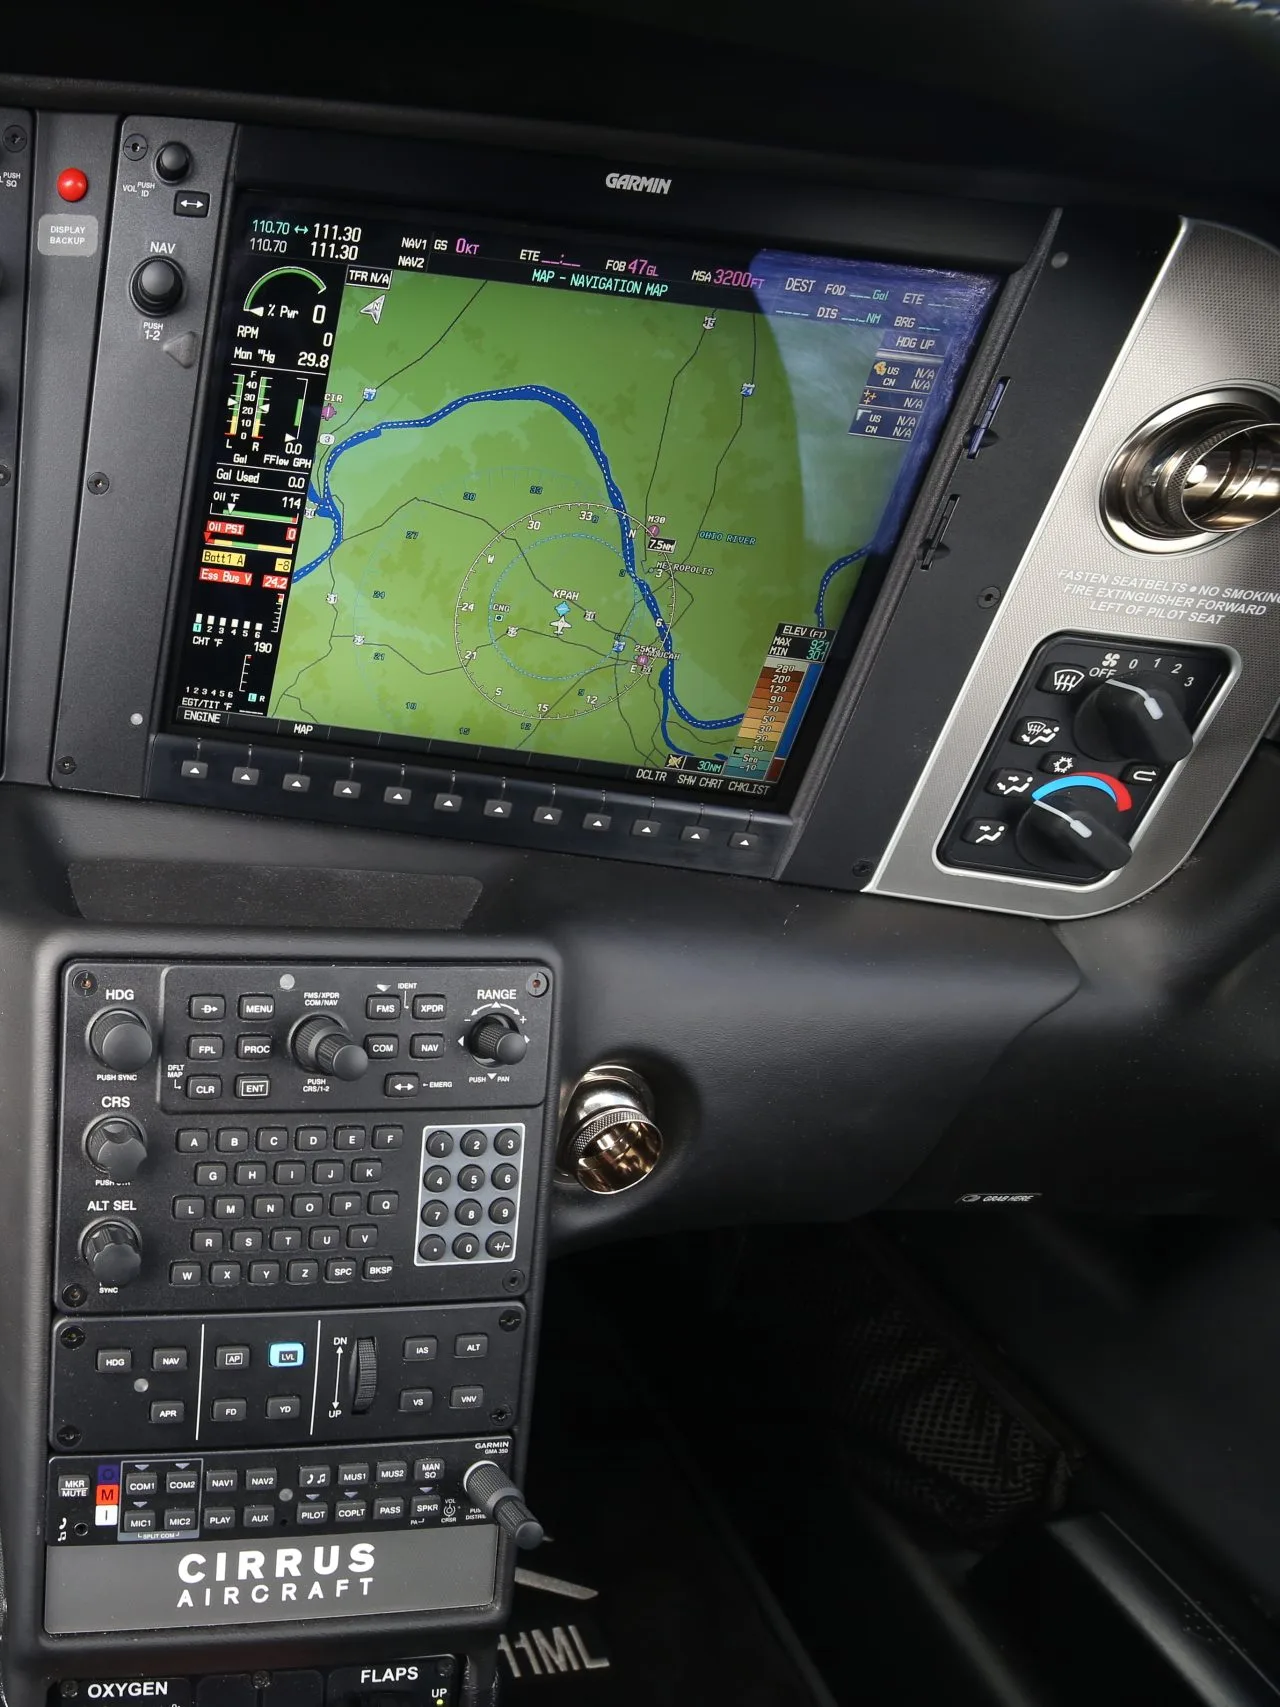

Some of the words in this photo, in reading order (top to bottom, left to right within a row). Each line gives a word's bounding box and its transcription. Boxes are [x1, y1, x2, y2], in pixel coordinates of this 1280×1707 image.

[123, 184, 137, 193] VOL
[605, 173, 672, 195] GARMIN
[50, 226, 85, 234] DISPLAY
[252, 219, 290, 235] 110.70
[313, 223, 362, 242] 111.30
[50, 237, 85, 245] BACKUP
[401, 236, 427, 250] NAV1
[150, 242, 176, 254] NAV
[249, 237, 287, 253] 110.70
[310, 241, 359, 260] 111.30
[398, 255, 425, 268] NAV2
[520, 249, 541, 262] ETE
[349, 270, 368, 282] TFR
[532, 269, 555, 283] MAP
[570, 273, 642, 294] NAVIGATION
[645, 282, 669, 297] MAP
[785, 278, 816, 293] DEST
[279, 307, 299, 319] Pwr
[143, 322, 163, 330] PUSH
[237, 325, 258, 339] RPM
[234, 349, 252, 360] Man
[298, 352, 329, 368] 29.8
[293, 457, 312, 468] GPH
[216, 468, 232, 480] Gal
[236, 470, 260, 484] Used
[213, 491, 226, 501] Oil
[282, 496, 300, 509] 114
[209, 522, 221, 531] Oil
[226, 524, 243, 534] PSI
[223, 571, 240, 583] Bus
[264, 576, 288, 589] 24.2
[1059, 570, 1108, 585] FASTEN
[1112, 576, 1187, 594] SEATBELTS
[1199, 586, 1219, 597] NO
[1064, 584, 1093, 597] FIRE
[1096, 589, 1194, 608] EXTINGUISHER
[1196, 600, 1267, 616] FORWARD
[1090, 601, 1121, 614] LEFT
[1126, 604, 1143, 616] OF
[1147, 607, 1186, 621] PILOT
[1189, 612, 1226, 625] SEAT
[782, 626, 807, 636] ELEV
[192, 636, 210, 646] CHT
[254, 642, 272, 653] 190
[773, 637, 792, 646] MAX
[810, 639, 830, 650] 921
[769, 646, 788, 656] MIN
[806, 650, 826, 662] 301
[184, 710, 221, 723] ENGINE
[294, 724, 313, 735] MAP
[636, 768, 668, 782] DCLTR
[728, 782, 770, 795] CHKLIST
[106, 990, 134, 1000] HDG
[477, 990, 517, 1000] RANGE
[101, 1096, 130, 1107] CRS
[87, 1201, 109, 1211] ALT
[113, 1200, 137, 1211] SEL
[335, 1268, 352, 1276] SPC
[369, 1266, 392, 1274] BKSP
[334, 1337, 347, 1345] DN
[281, 1353, 295, 1361] LVL
[382, 1469, 404, 1478] MUS2
[130, 1482, 155, 1491] COM1
[252, 1477, 274, 1485] NAV2
[339, 1508, 365, 1518] COPLT
[380, 1506, 401, 1515] PASS
[417, 1504, 438, 1512] SPKR
[301, 1511, 325, 1520] PILOT
[177, 1542, 376, 1584] CIRRUS
[177, 1577, 374, 1609] AIRCRAFT
[360, 1666, 418, 1685] FLAPS
[87, 1681, 168, 1700] OXYGEN
